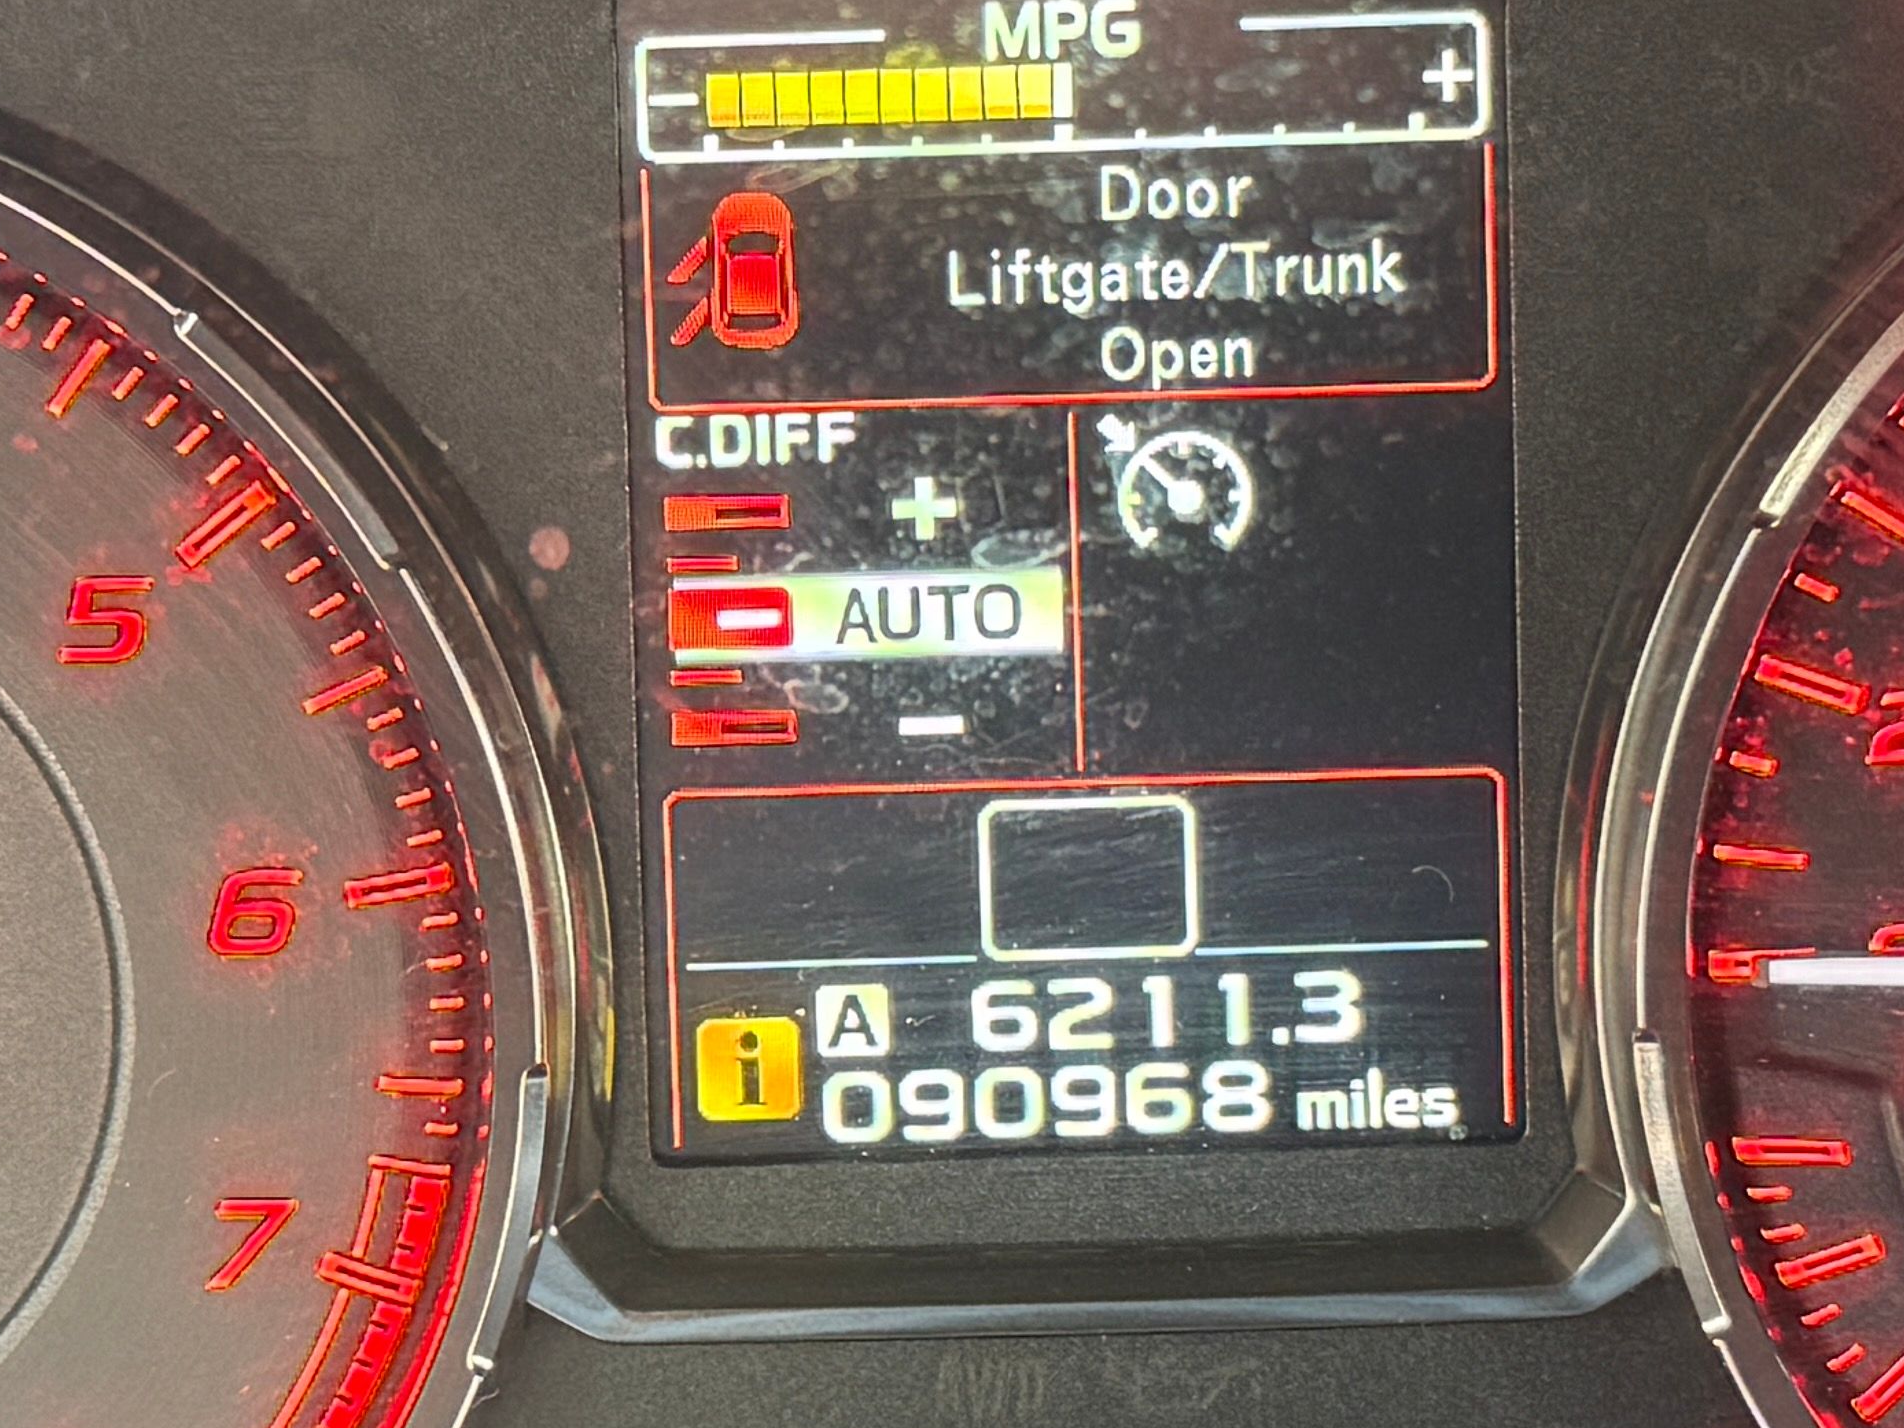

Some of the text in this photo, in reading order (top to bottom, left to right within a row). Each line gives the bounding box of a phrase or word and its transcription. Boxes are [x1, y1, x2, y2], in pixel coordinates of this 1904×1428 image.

[1099, 165, 1254, 222] Door
[947, 238, 1406, 316] Liftgate/Trunk
[1100, 326, 1256, 389] Open
[653, 410, 858, 469] C.DIFF
[56, 575, 156, 665] 5
[835, 584, 1023, 646] AUTO
[206, 868, 303, 959] 6
[828, 969, 1364, 1053] A 6211.3
[821, 1059, 1460, 1145] 090968 miles
[204, 1197, 300, 1293] 7
